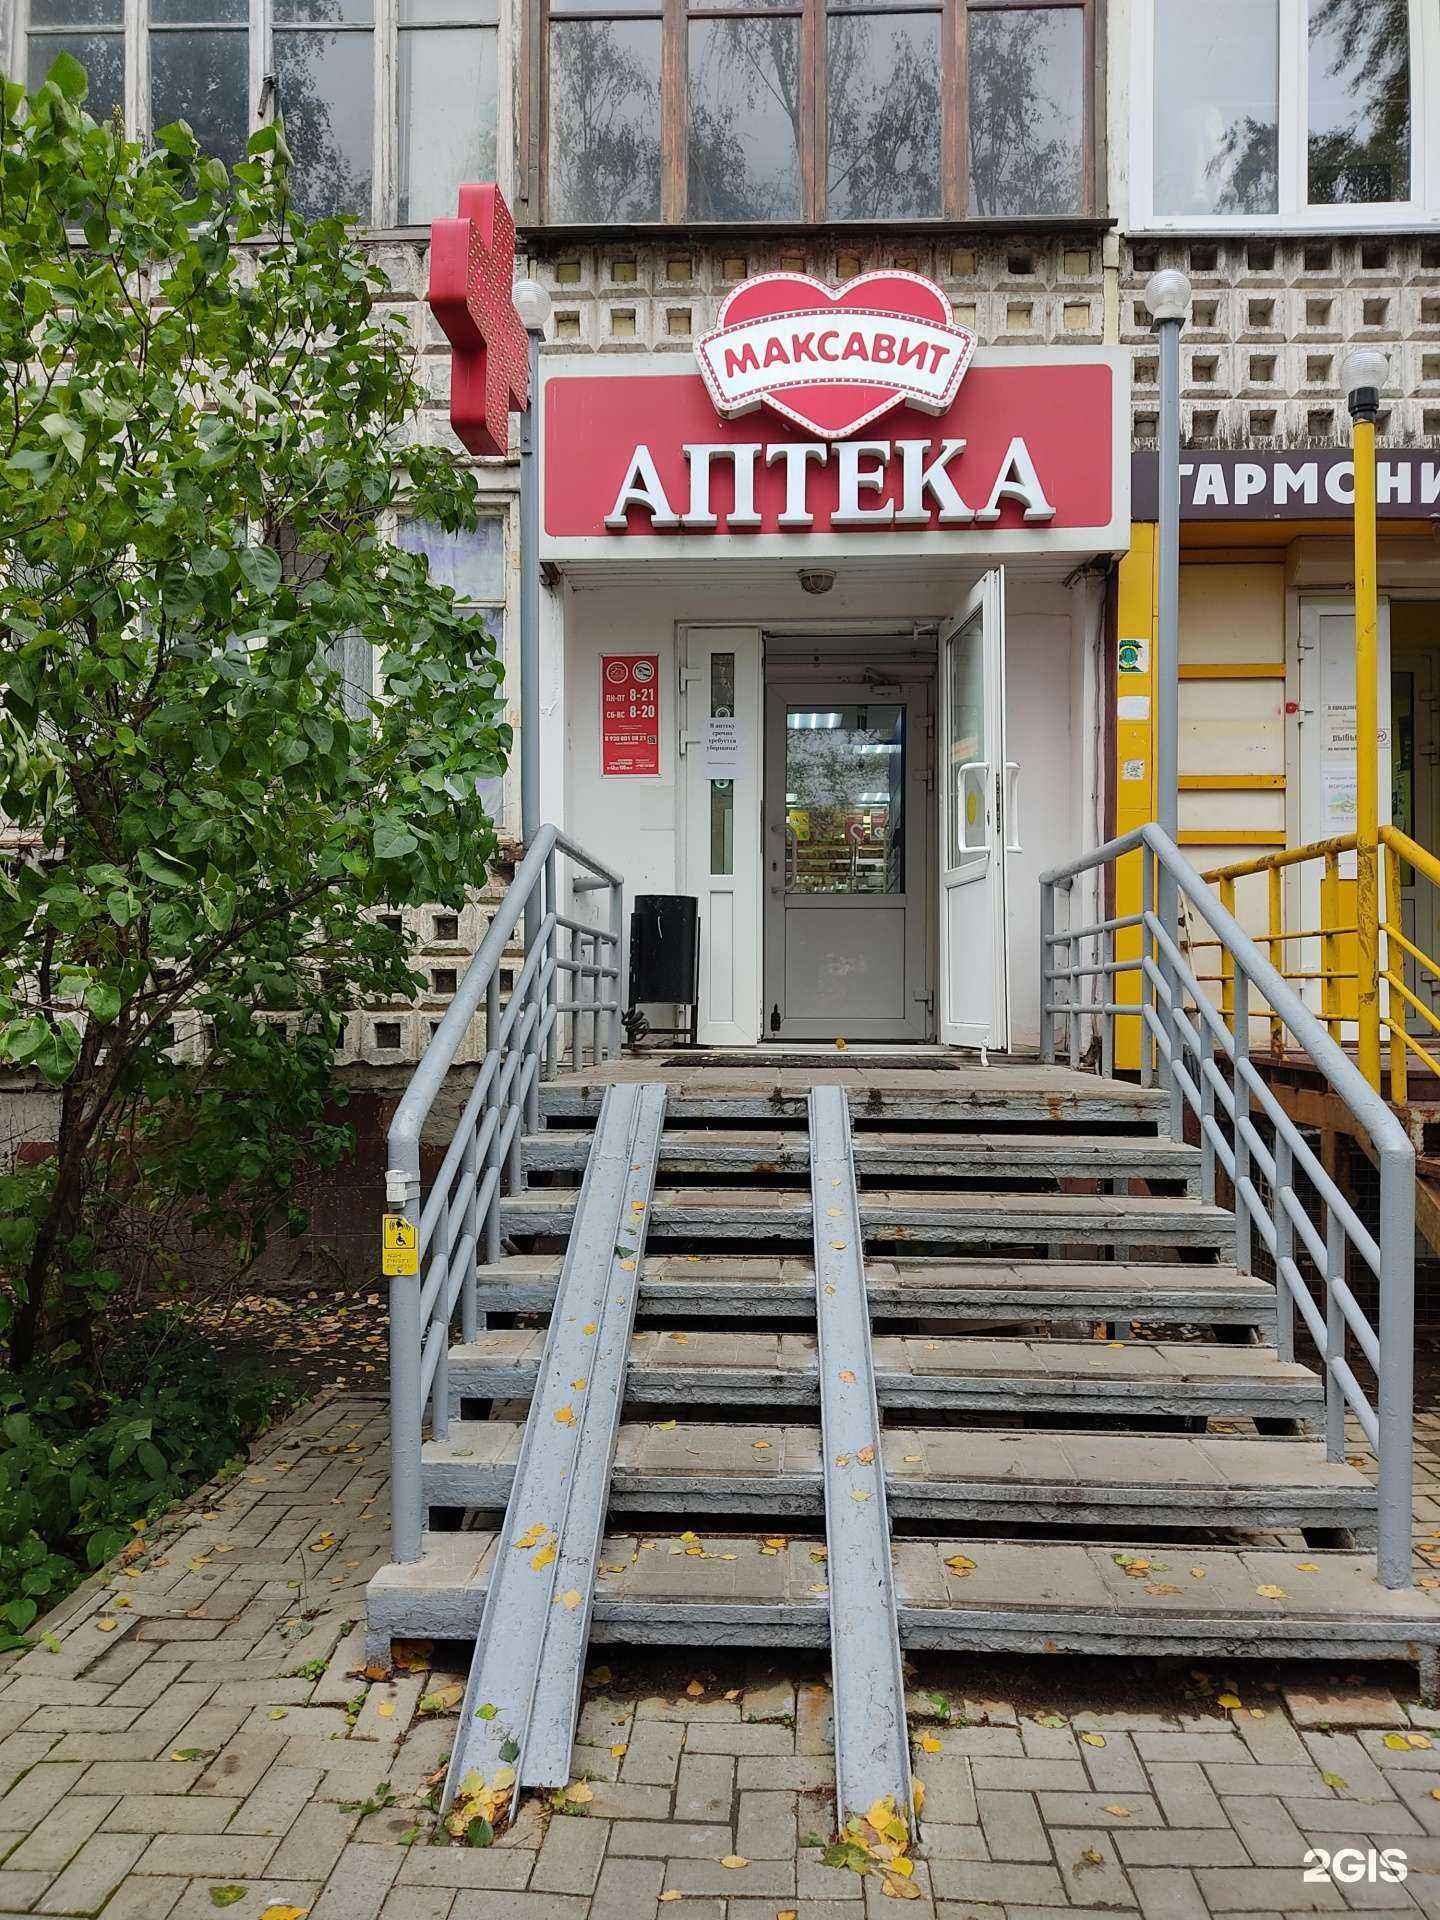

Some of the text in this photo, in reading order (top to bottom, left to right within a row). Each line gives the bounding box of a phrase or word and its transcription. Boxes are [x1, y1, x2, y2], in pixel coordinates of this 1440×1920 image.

[723, 330, 950, 378] МАКСАВИТ
[604, 437, 1056, 528] АПТЕКА
[630, 688, 654, 701] 8-21
[630, 704, 655, 718] 8-20
